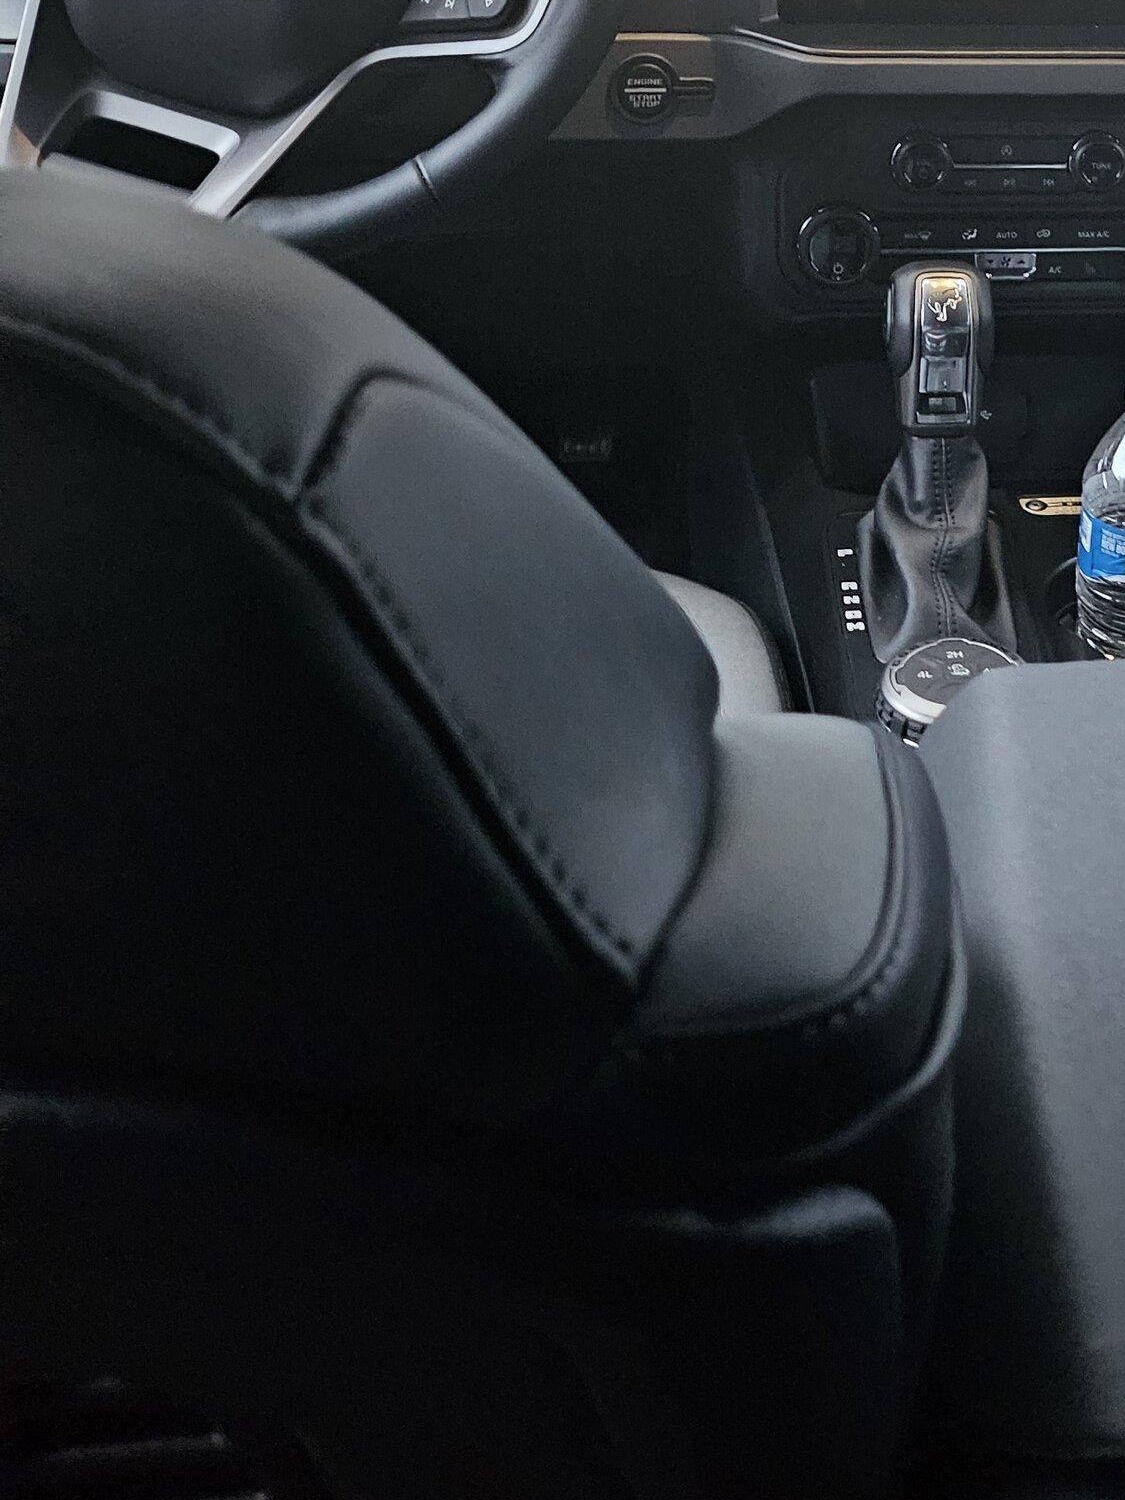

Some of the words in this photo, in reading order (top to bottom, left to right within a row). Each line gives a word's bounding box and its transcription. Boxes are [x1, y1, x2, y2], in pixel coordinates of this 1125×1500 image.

[627, 78, 663, 86] ENGINE
[629, 94, 662, 102] START
[633, 100, 660, 108] STOP
[1092, 162, 1112, 170] TUNE
[1097, 230, 1110, 238] A/C
[1049, 265, 1062, 274] A/C
[946, 650, 963, 659] 2H
[917, 670, 933, 679] 4L
